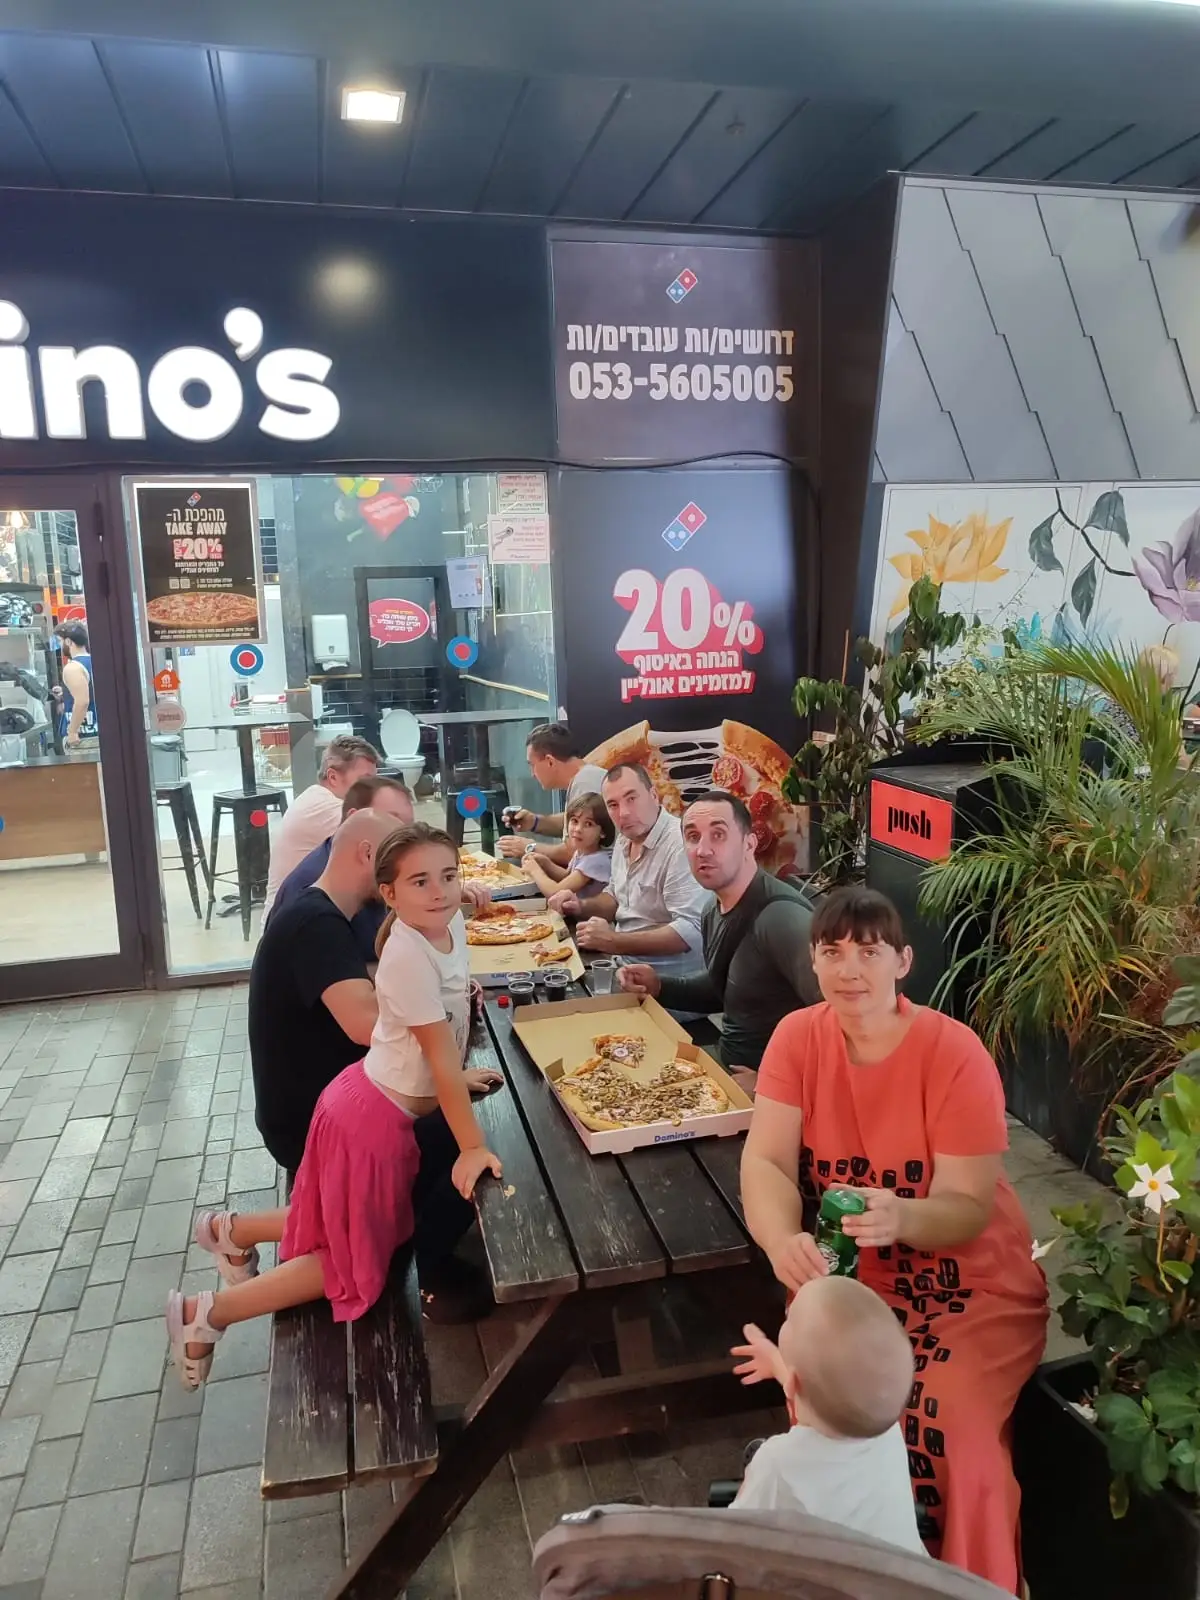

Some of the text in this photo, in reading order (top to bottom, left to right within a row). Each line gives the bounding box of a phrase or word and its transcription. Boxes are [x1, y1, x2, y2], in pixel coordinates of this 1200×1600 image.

[566, 324, 794, 356] דרושים/ות עובדים/ות
[569, 361, 794, 402] 053-5605005
[165, 522, 227, 535] TAKE AWAY
[185, 508, 225, 522] מהפכת
[181, 537, 223, 560] 20%
[613, 568, 757, 651] 20%
[633, 650, 739, 675] הנחה באיסוף
[621, 671, 753, 700] למזמינים אונליין
[888, 806, 931, 840] push
[654, 1131, 695, 1143] Domino's
